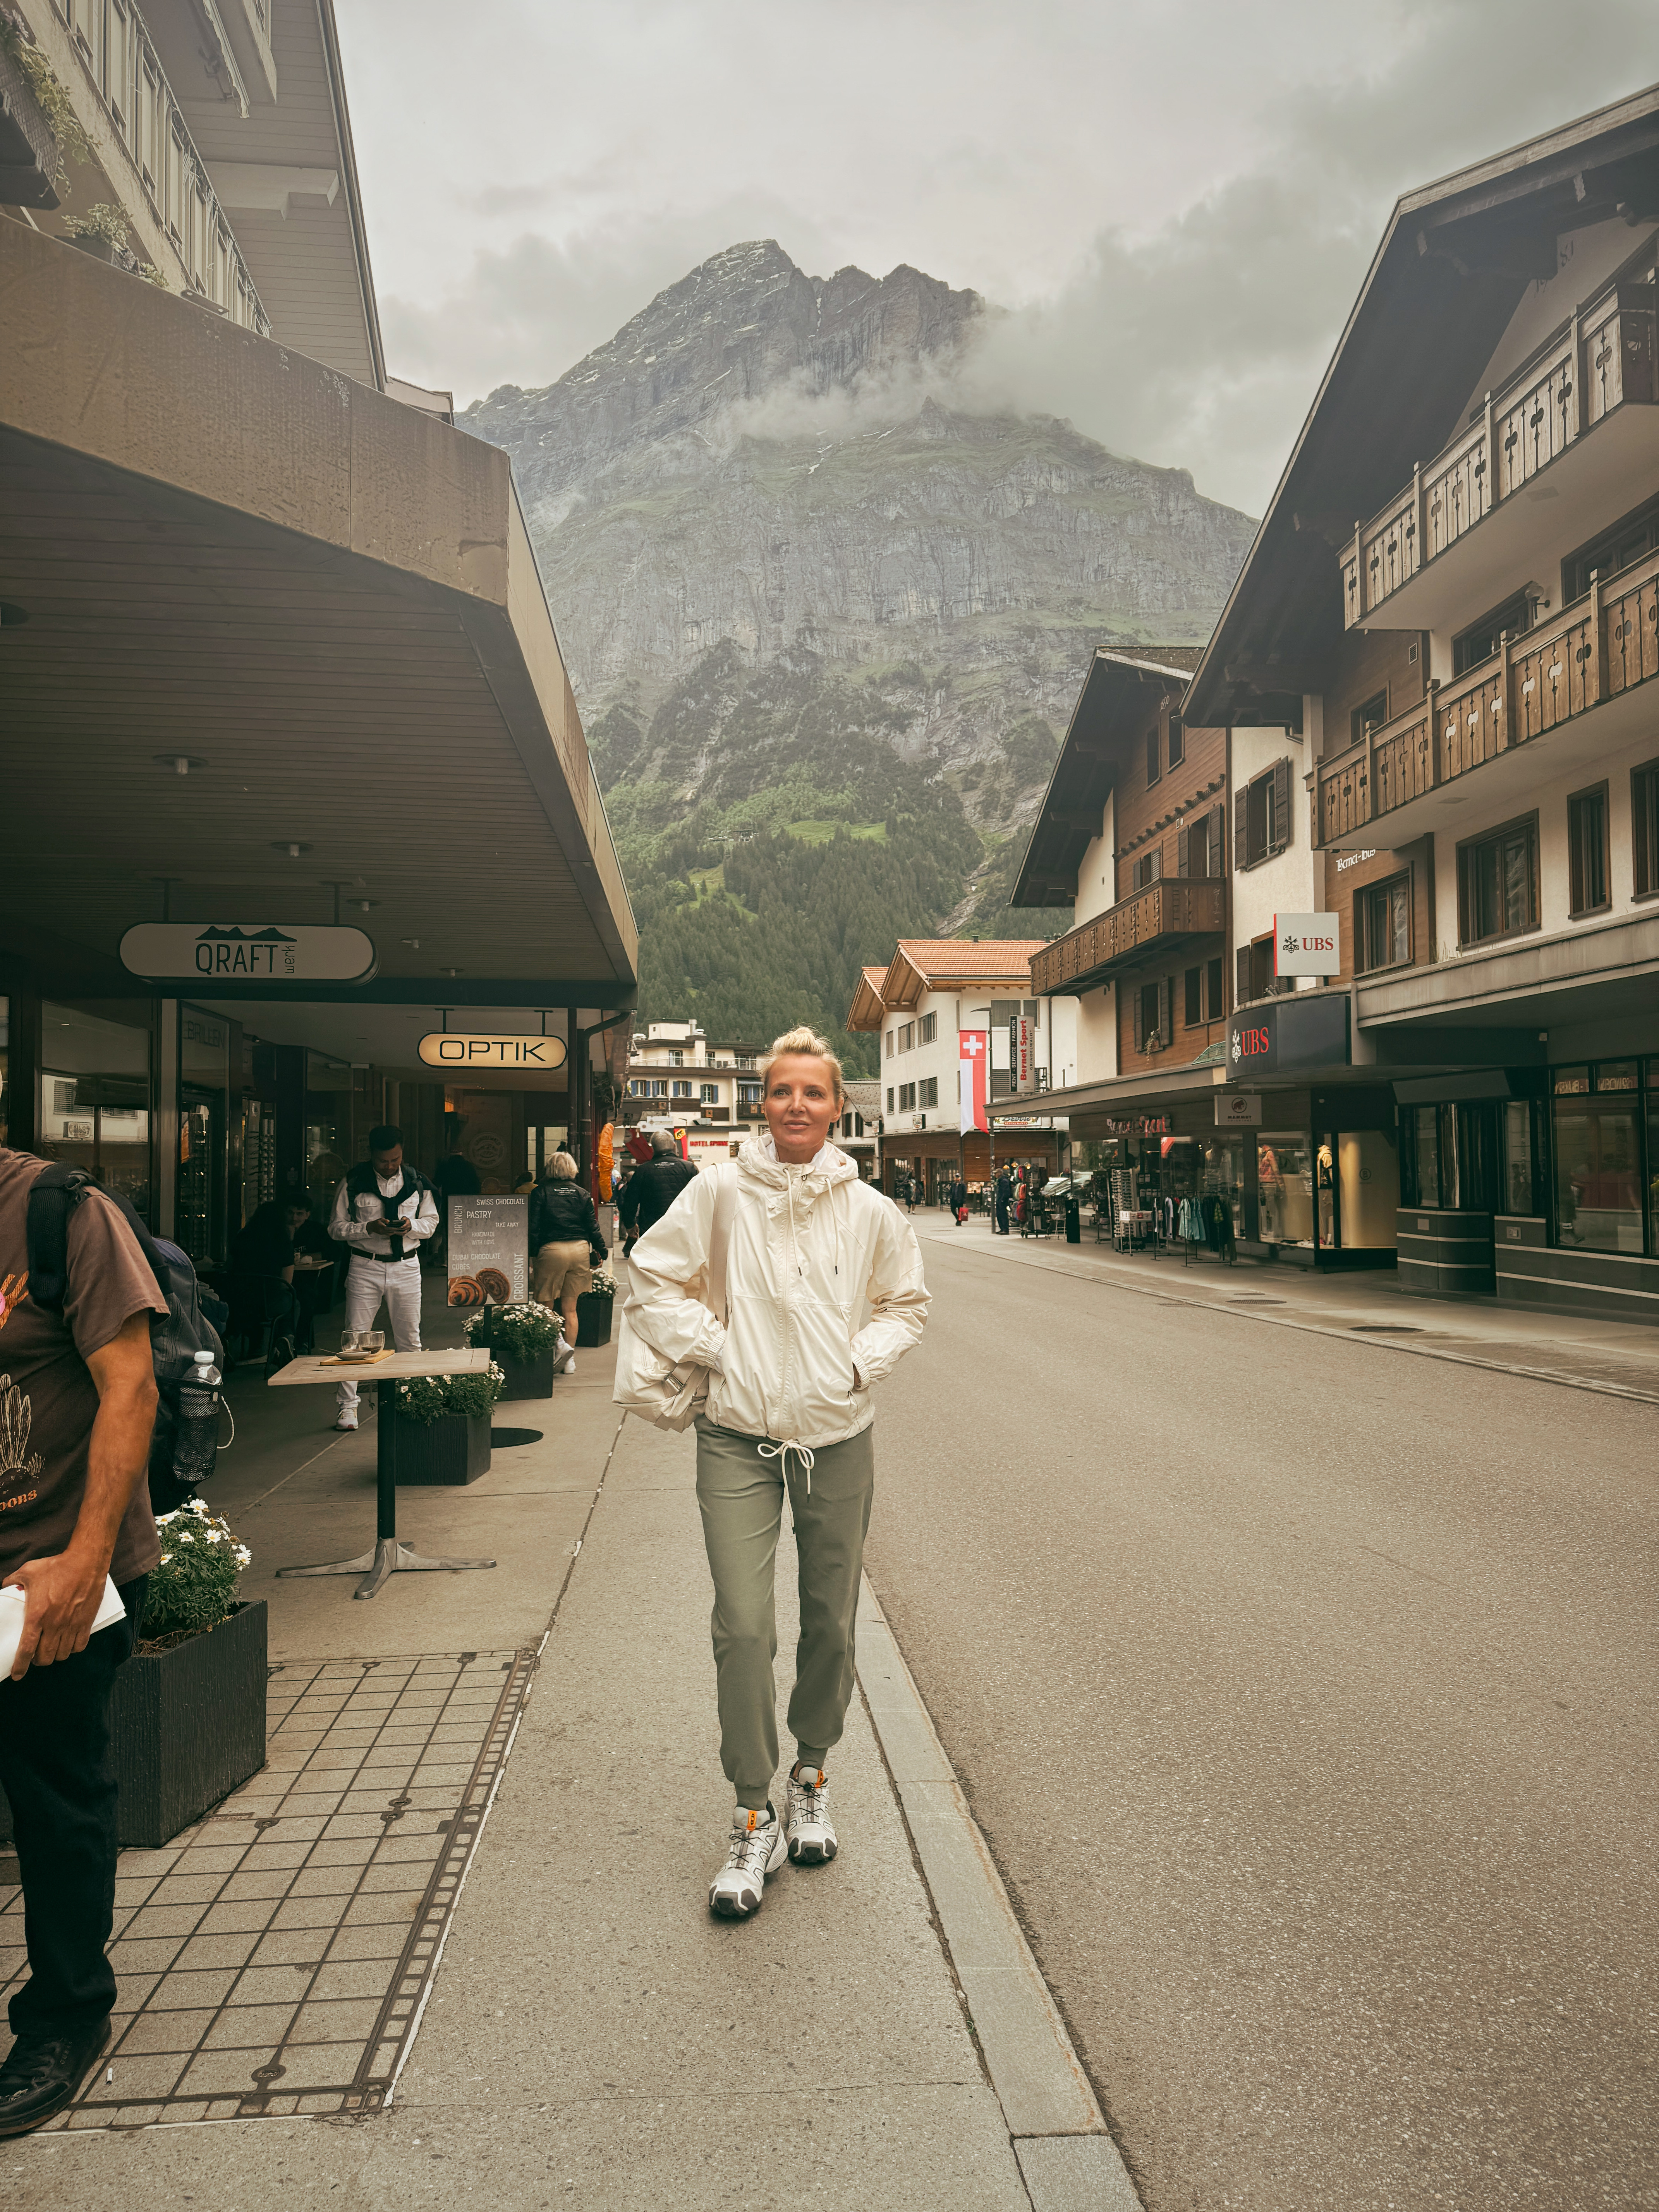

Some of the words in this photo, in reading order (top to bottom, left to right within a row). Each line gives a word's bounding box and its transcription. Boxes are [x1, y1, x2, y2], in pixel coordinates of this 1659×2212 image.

[1302, 937, 1334, 951] UBS
[196, 943, 278, 975] QRAFT
[281, 945, 295, 974] werk
[1020, 1020, 1028, 1046] Sport
[1241, 1027, 1269, 1056] UBS
[440, 1040, 546, 1062] OPTIK
[454, 1206, 463, 1233] BRUNCH
[467, 1211, 492, 1219] PASTRY
[514, 1253, 524, 1300] CROISSANT
